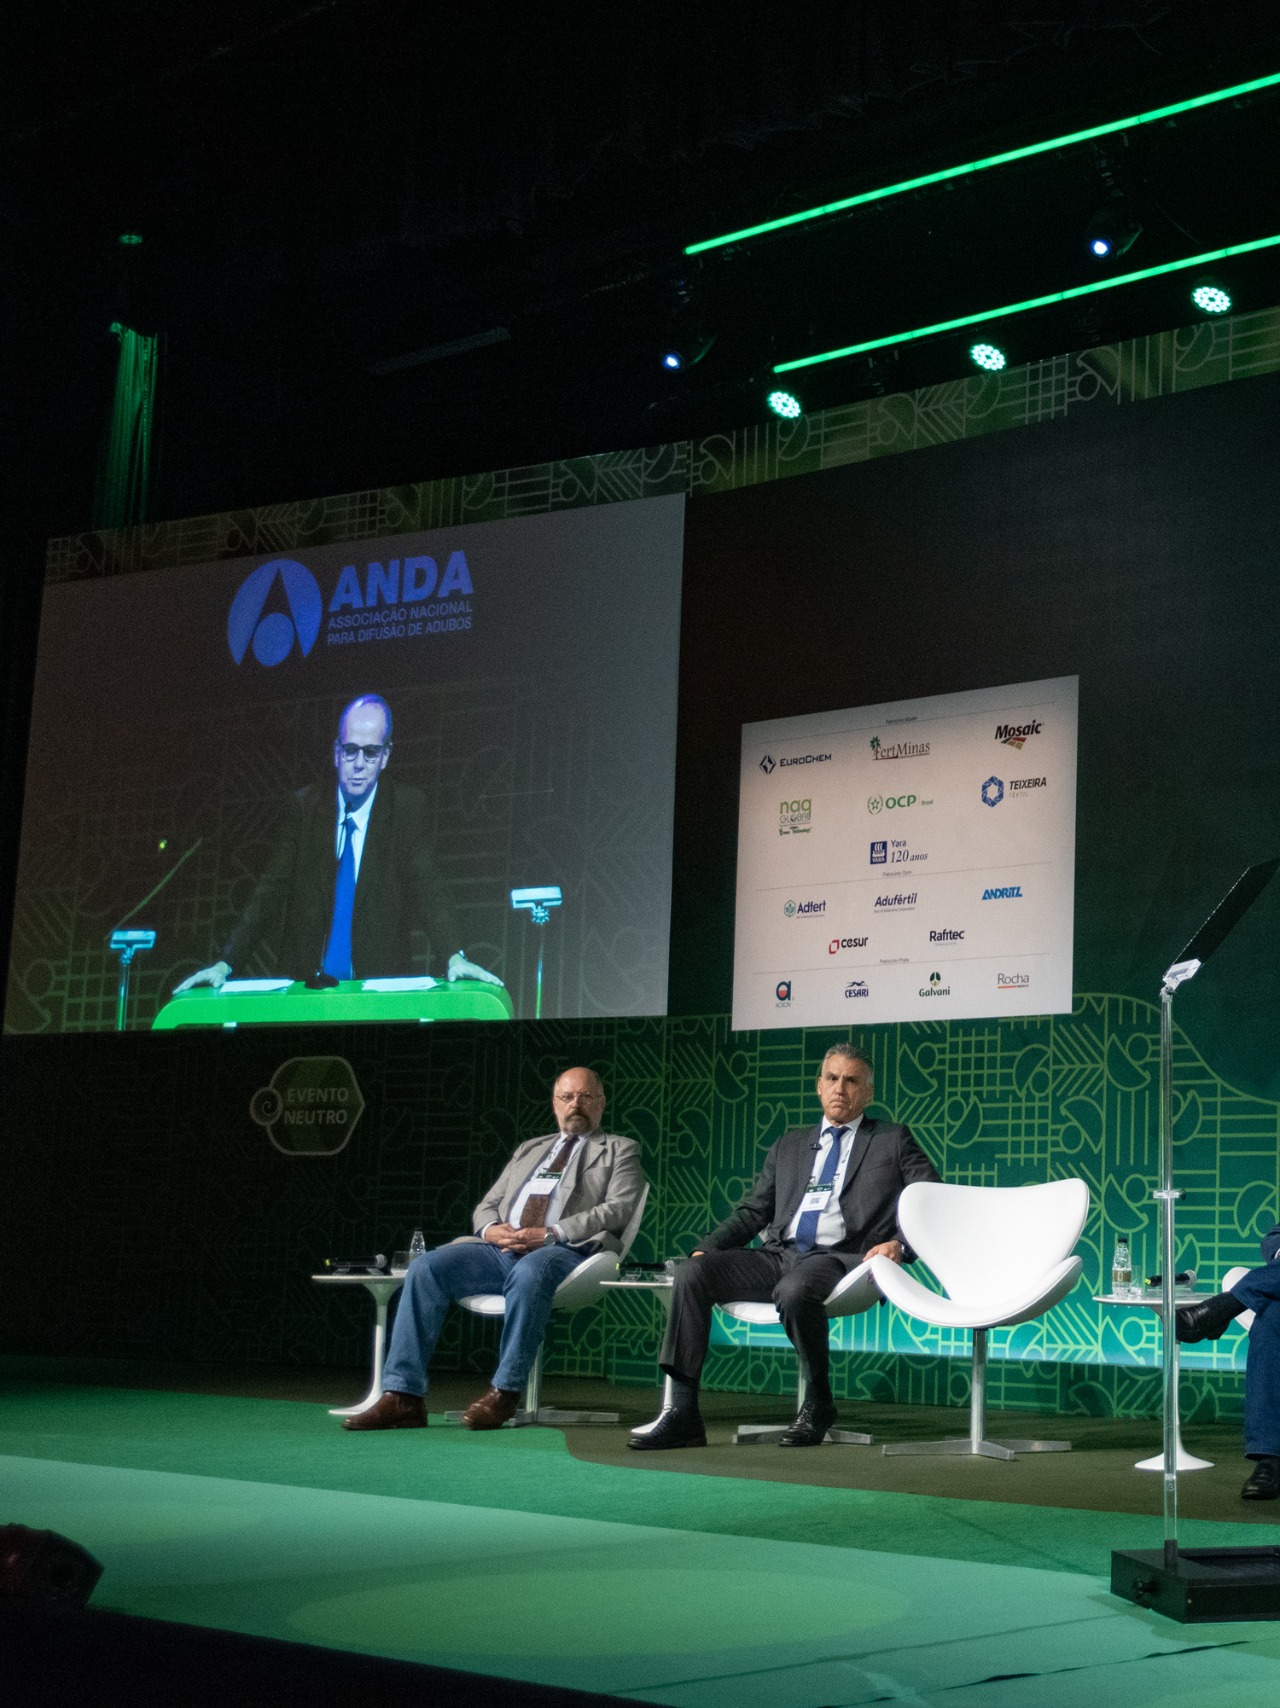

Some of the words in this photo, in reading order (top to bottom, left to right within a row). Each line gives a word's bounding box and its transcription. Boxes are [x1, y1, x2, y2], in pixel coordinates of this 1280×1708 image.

[329, 550, 474, 612] ANDA
[328, 607, 407, 630] ASSOCIAÇÃO
[410, 600, 473, 620] NACIONAL
[327, 631, 356, 646] PARA
[358, 622, 406, 642] DIFUSÃO
[407, 622, 423, 636] DE
[425, 616, 472, 634] ADUBOS
[994, 719, 1042, 740] Mosaic
[1009, 777, 1047, 791] TEIXEIRA
[885, 794, 917, 810] OCP
[890, 840, 907, 848] Yara
[890, 849, 910, 863] 120
[909, 853, 929, 862] anos
[797, 900, 826, 914] Adfert
[874, 893, 918, 907] Adufértil
[841, 936, 868, 949] cesur
[997, 973, 1030, 985] Rocha
[844, 988, 869, 998] CESARI
[918, 986, 951, 997] Galvani
[287, 1087, 349, 1103] EVENTO
[284, 1109, 348, 1125] NEUTRO
